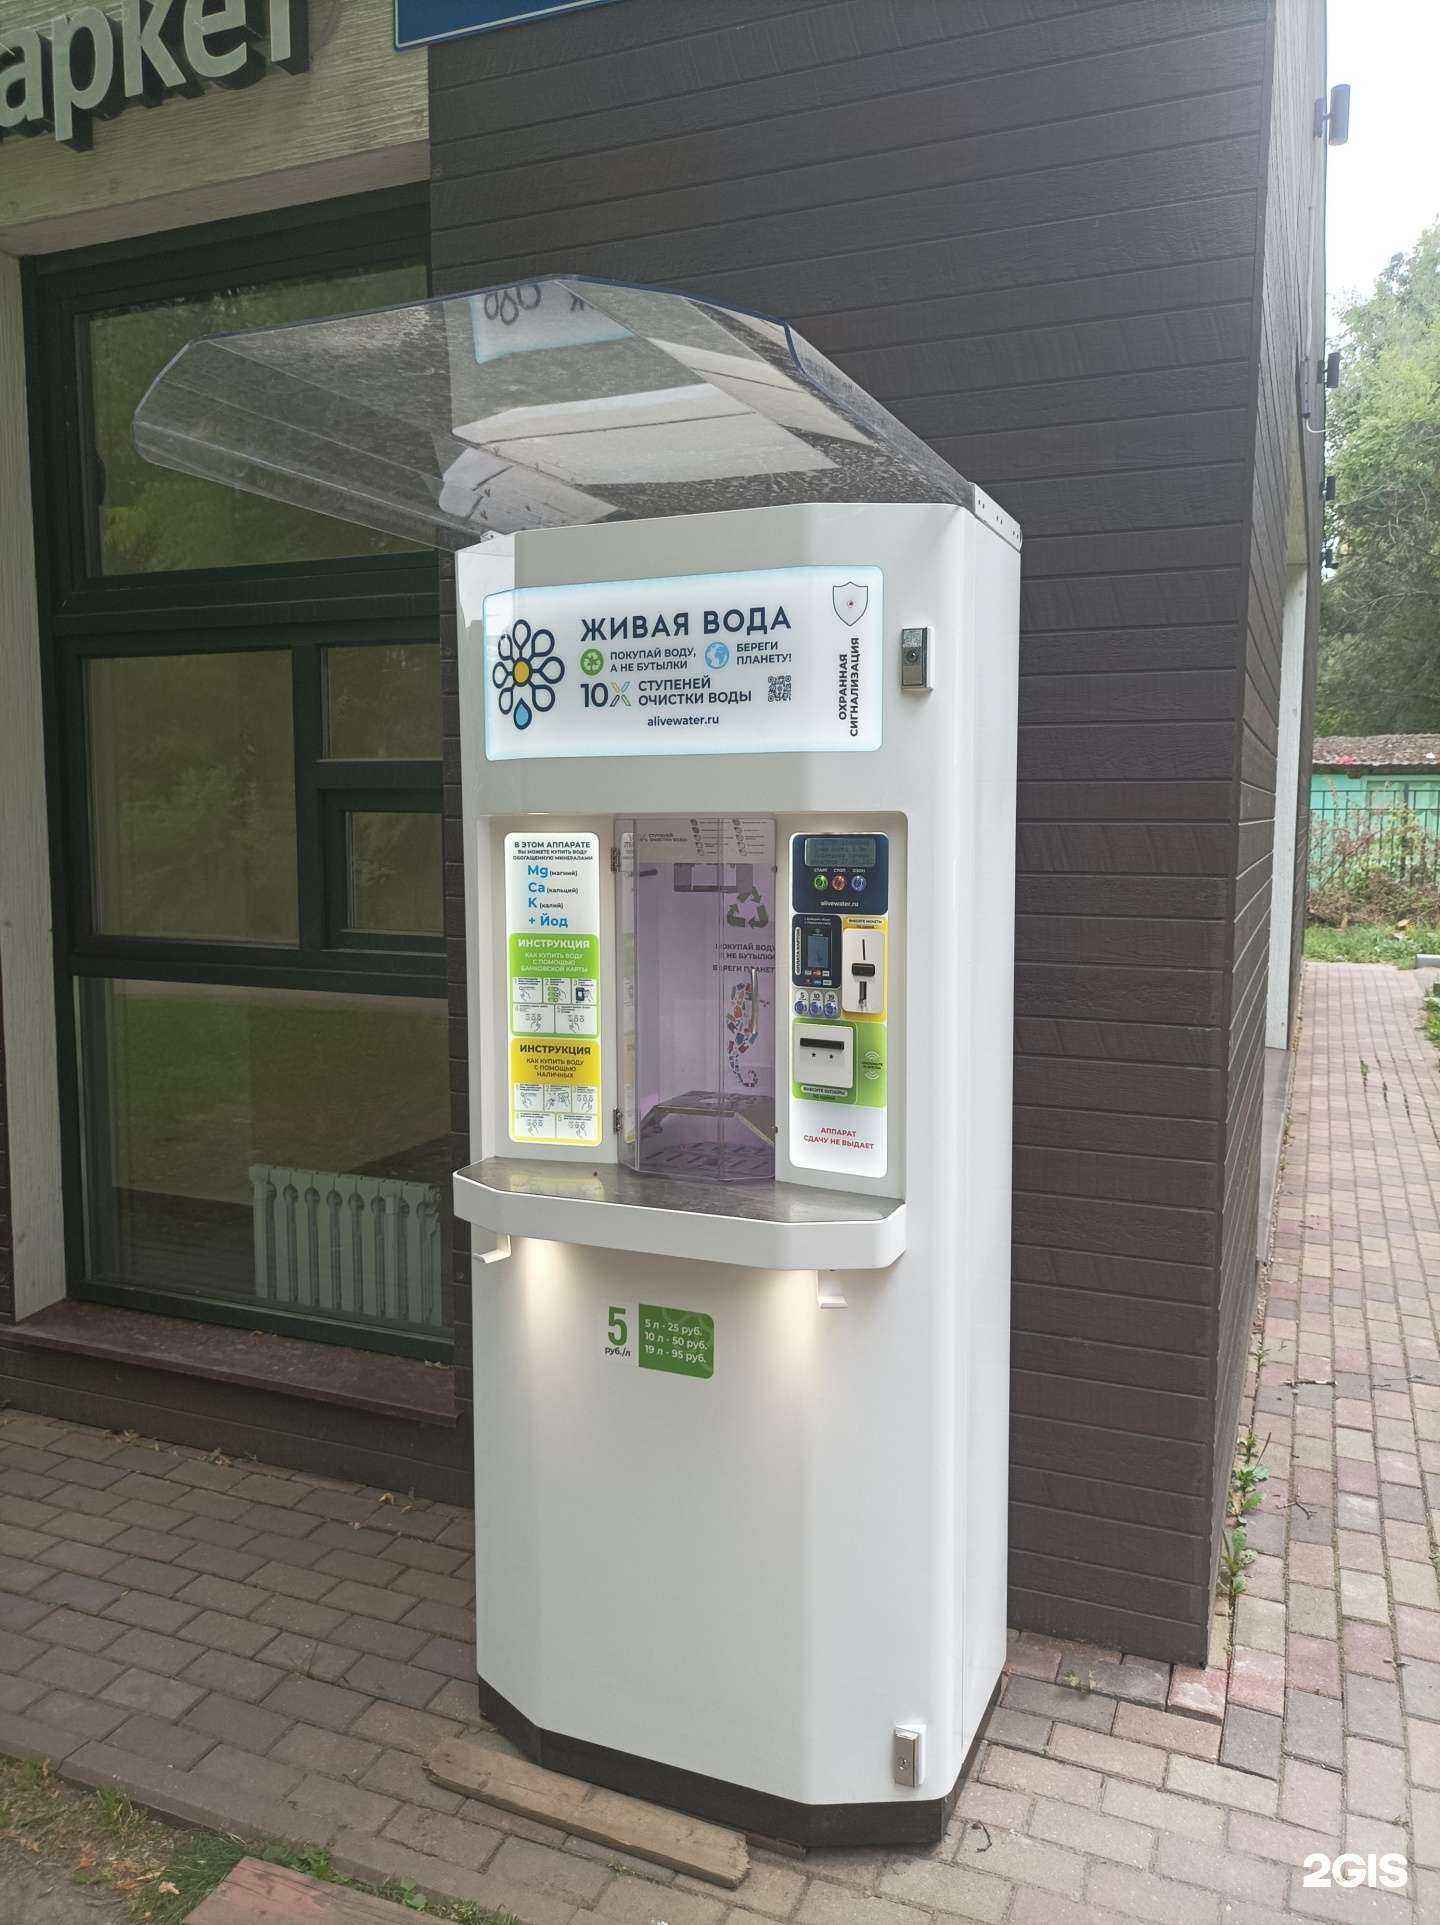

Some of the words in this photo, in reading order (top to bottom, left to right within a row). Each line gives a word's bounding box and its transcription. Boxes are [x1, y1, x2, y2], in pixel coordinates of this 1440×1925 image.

[580, 612, 689, 642] ЖИВАЯ
[703, 605, 792, 636] ВОДА
[610, 648, 662, 661] ПОКУПАЙ
[664, 647, 697, 659] ВОДУ,
[736, 641, 778, 653] БЕРЕГИ
[610, 664, 618, 673] А
[620, 662, 634, 672] НЕ
[637, 660, 688, 672] БУТЫЛКИ
[736, 653, 792, 666] ПЛАНЕТУ!
[638, 674, 711, 692] СТУПЕНЕЙ
[838, 653, 848, 721] ОХРАННАЯ
[849, 637, 861, 737] СИГНАЛИЗАЦИЯ
[638, 691, 704, 707] ОЧИСТКИ
[708, 690, 752, 705] ВОДЫ
[647, 714, 719, 727] alivewater.ru
[514, 841, 521, 849] В
[521, 841, 545, 849] ЭТОМ
[546, 841, 591, 849] АППАРАТЕ
[527, 864, 549, 878] Mg
[528, 882, 545, 893] Ca
[540, 912, 568, 928] Йод
[517, 939, 591, 950] ИНСТРУКЦИЯ
[712, 964, 742, 972] БРЕГИ
[519, 1044, 592, 1056] ИНСТРУКЦИЯ
[566, 1059, 584, 1067] ВОДУ
[820, 1126, 857, 1137] АППАРАТ
[803, 1134, 829, 1145] СДАЧУ
[830, 1138, 840, 1146] НЕ
[841, 1139, 875, 1150] ВЫДАЕТ
[608, 1305, 628, 1346] 5
[645, 1319, 651, 1328] 5
[653, 1321, 660, 1329] л
[668, 1322, 679, 1333] 25
[681, 1325, 703, 1336] руб.
[645, 1331, 655, 1341] 10
[672, 1336, 684, 1346] 50
[686, 1340, 708, 1350] руб.
[604, 1346, 631, 1358] руб./л
[645, 1344, 655, 1354] 19
[672, 1348, 684, 1359] 95
[686, 1353, 707, 1364] руб.
